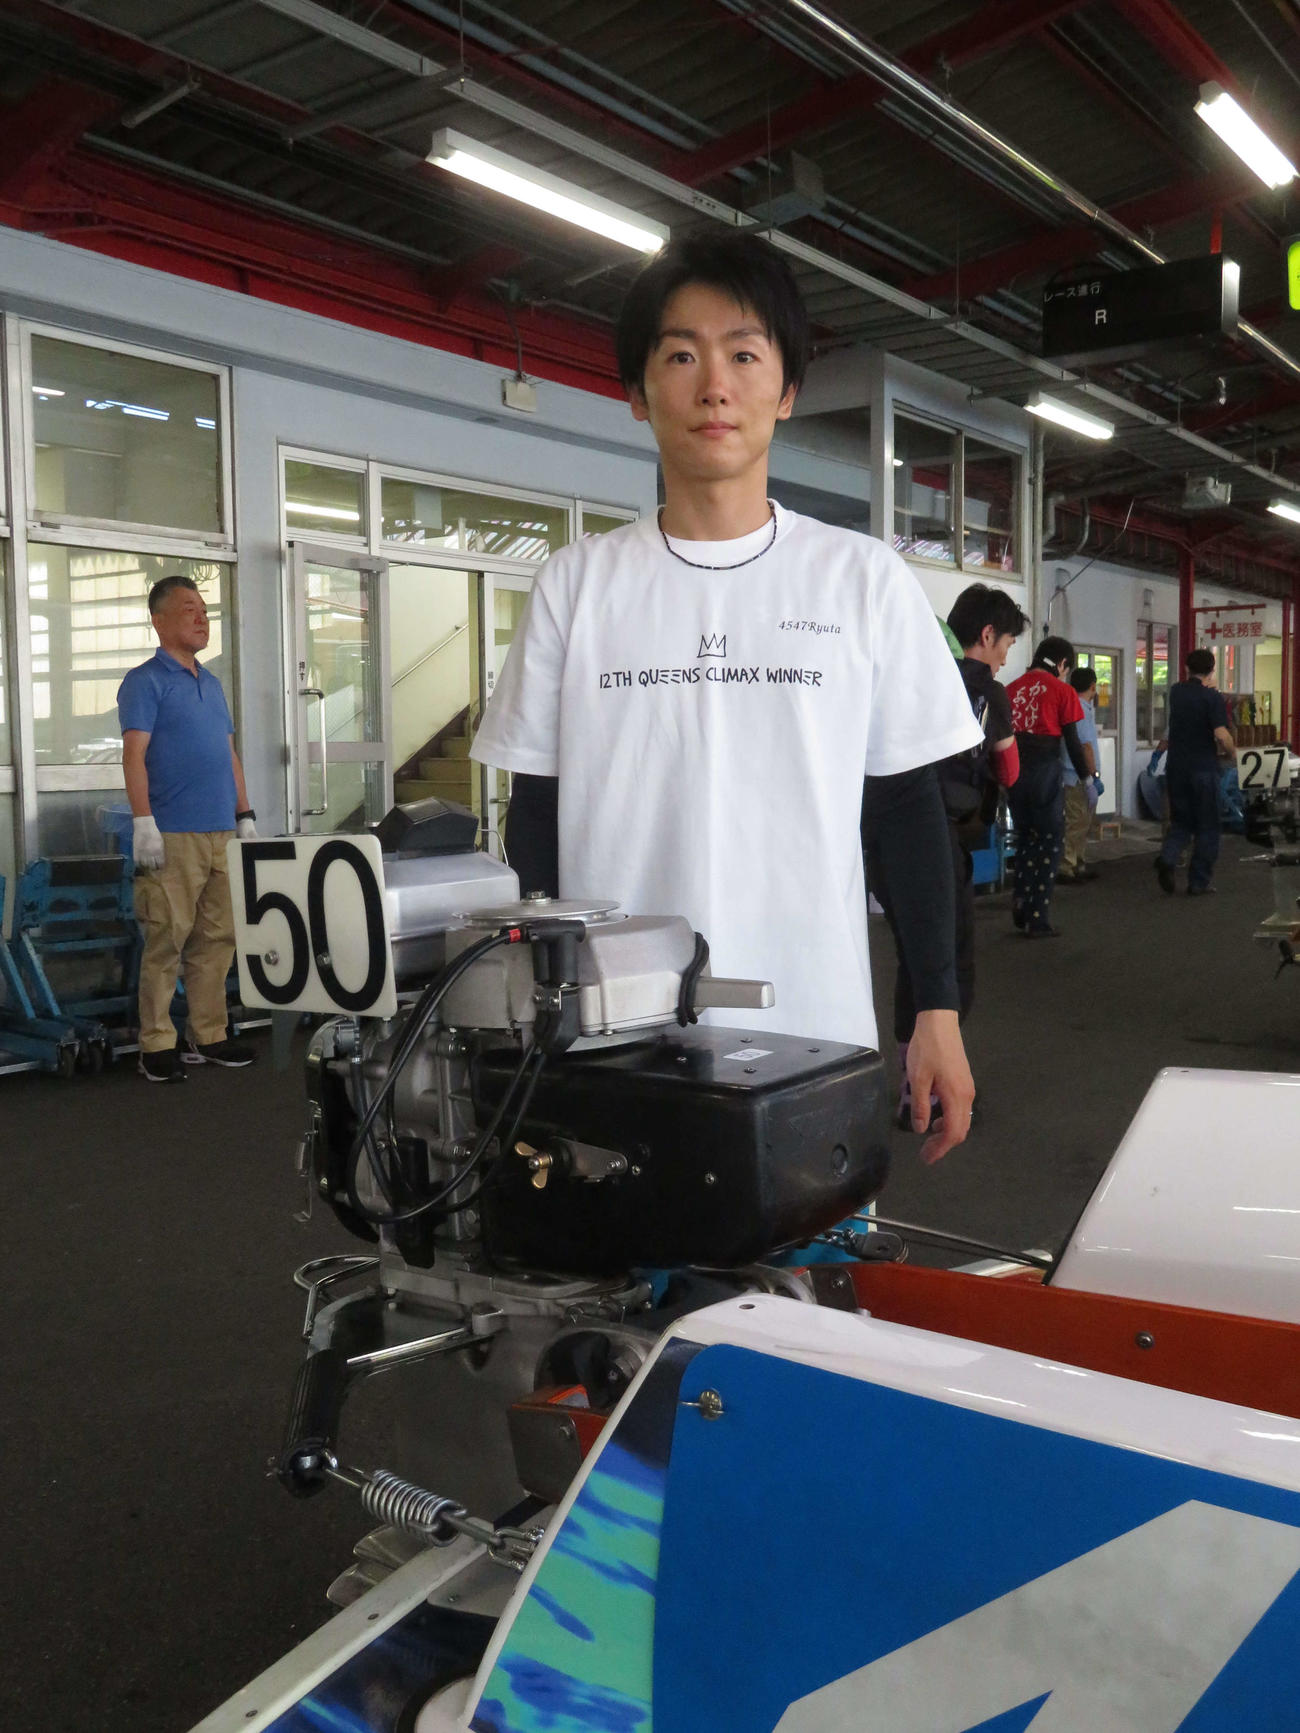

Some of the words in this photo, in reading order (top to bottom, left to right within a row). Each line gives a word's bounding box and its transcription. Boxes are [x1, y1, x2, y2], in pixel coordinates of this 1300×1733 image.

[1095, 309, 1107, 325] R
[778, 620, 841, 635] 4547Ryuta
[1223, 622, 1263, 638] 医務室
[599, 671, 632, 689] 12TH
[638, 668, 700, 687] QUEENS
[705, 666, 760, 685] CLIMAX
[766, 667, 823, 687] WINNER
[1241, 749, 1285, 789] 27
[241, 840, 386, 1012] 50
